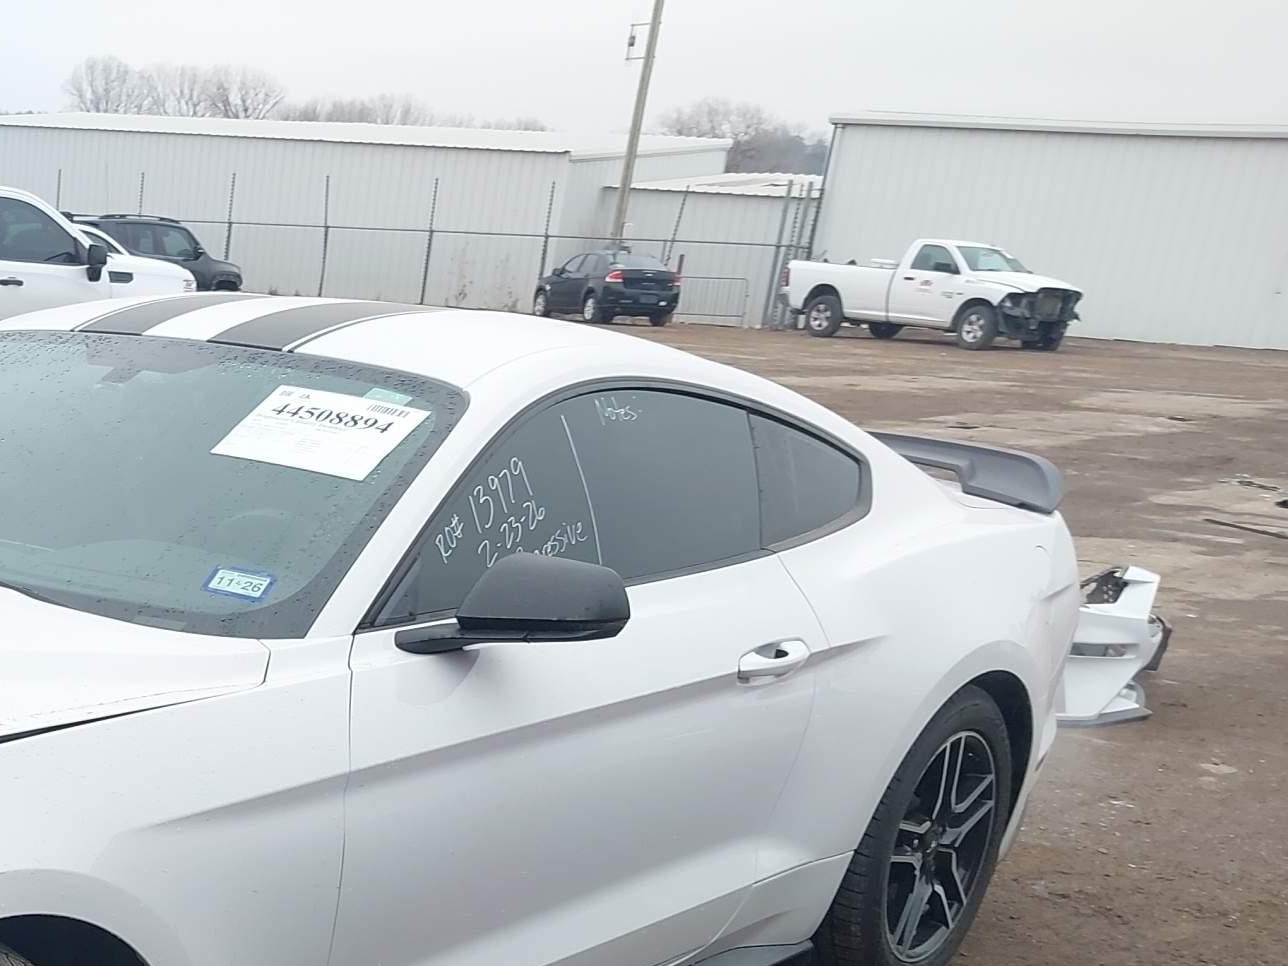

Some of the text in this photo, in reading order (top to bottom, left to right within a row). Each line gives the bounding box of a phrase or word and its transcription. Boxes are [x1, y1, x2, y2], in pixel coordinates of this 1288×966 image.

[272, 402, 394, 434] 44508894
[468, 457, 533, 534] 13979
[478, 500, 546, 568] 2-23-26
